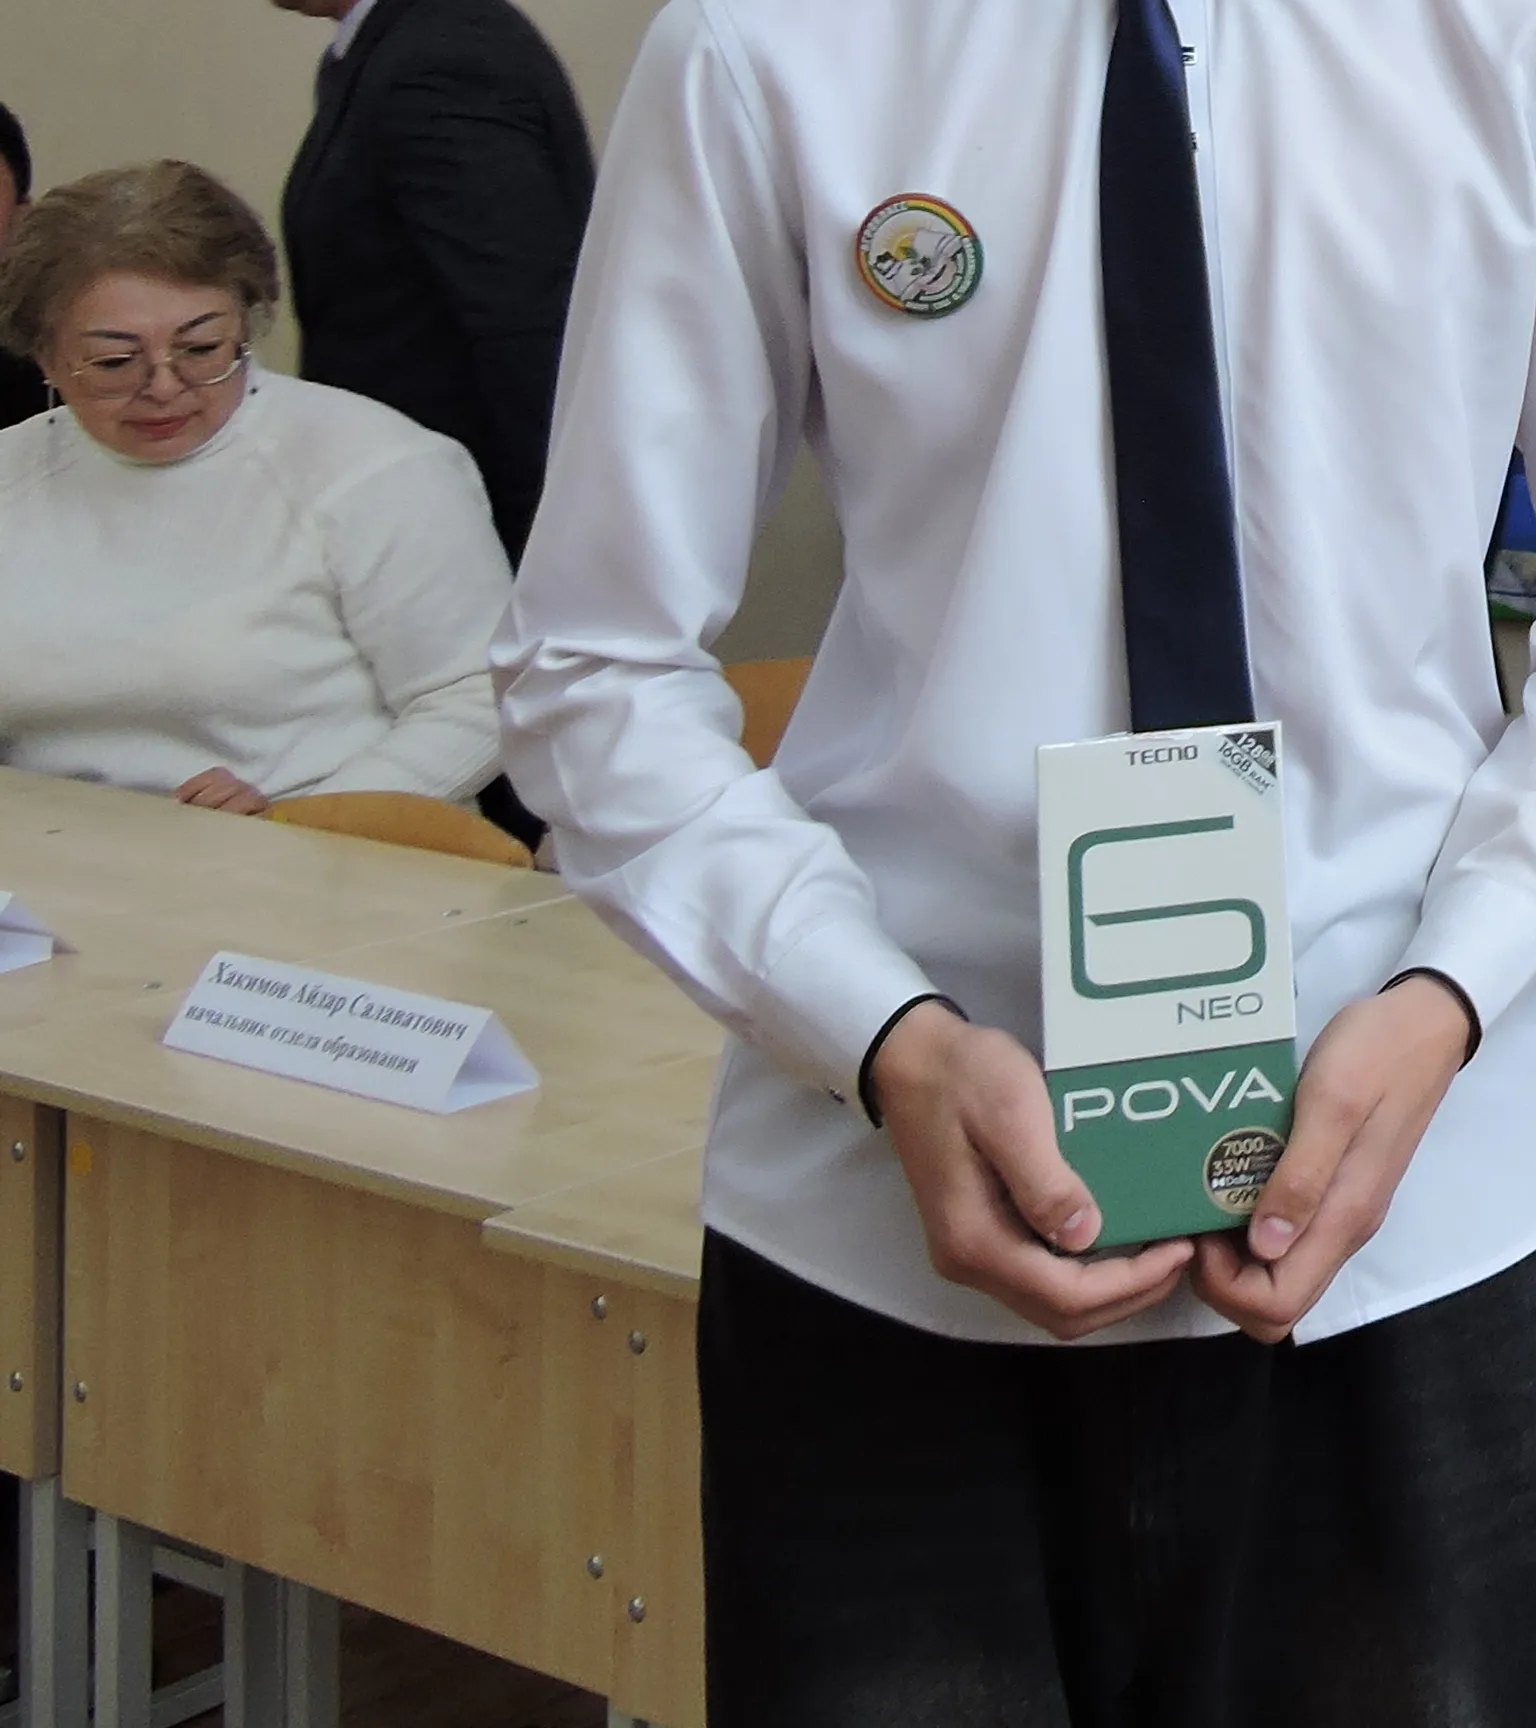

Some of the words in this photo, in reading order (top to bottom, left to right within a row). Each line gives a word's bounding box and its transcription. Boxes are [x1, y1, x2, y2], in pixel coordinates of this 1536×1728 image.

[1125, 745, 1199, 766] TECNO
[1067, 815, 1266, 1000] 6
[208, 961, 292, 999] Хакимов
[291, 982, 347, 1017] Айдар
[348, 993, 469, 1041] Салаватович
[1177, 992, 1264, 1025] NEO
[184, 1003, 270, 1038] начальник
[322, 1035, 420, 1074] образования
[1064, 1067, 1284, 1133] POVA
[1222, 1137, 1264, 1158] 7000
